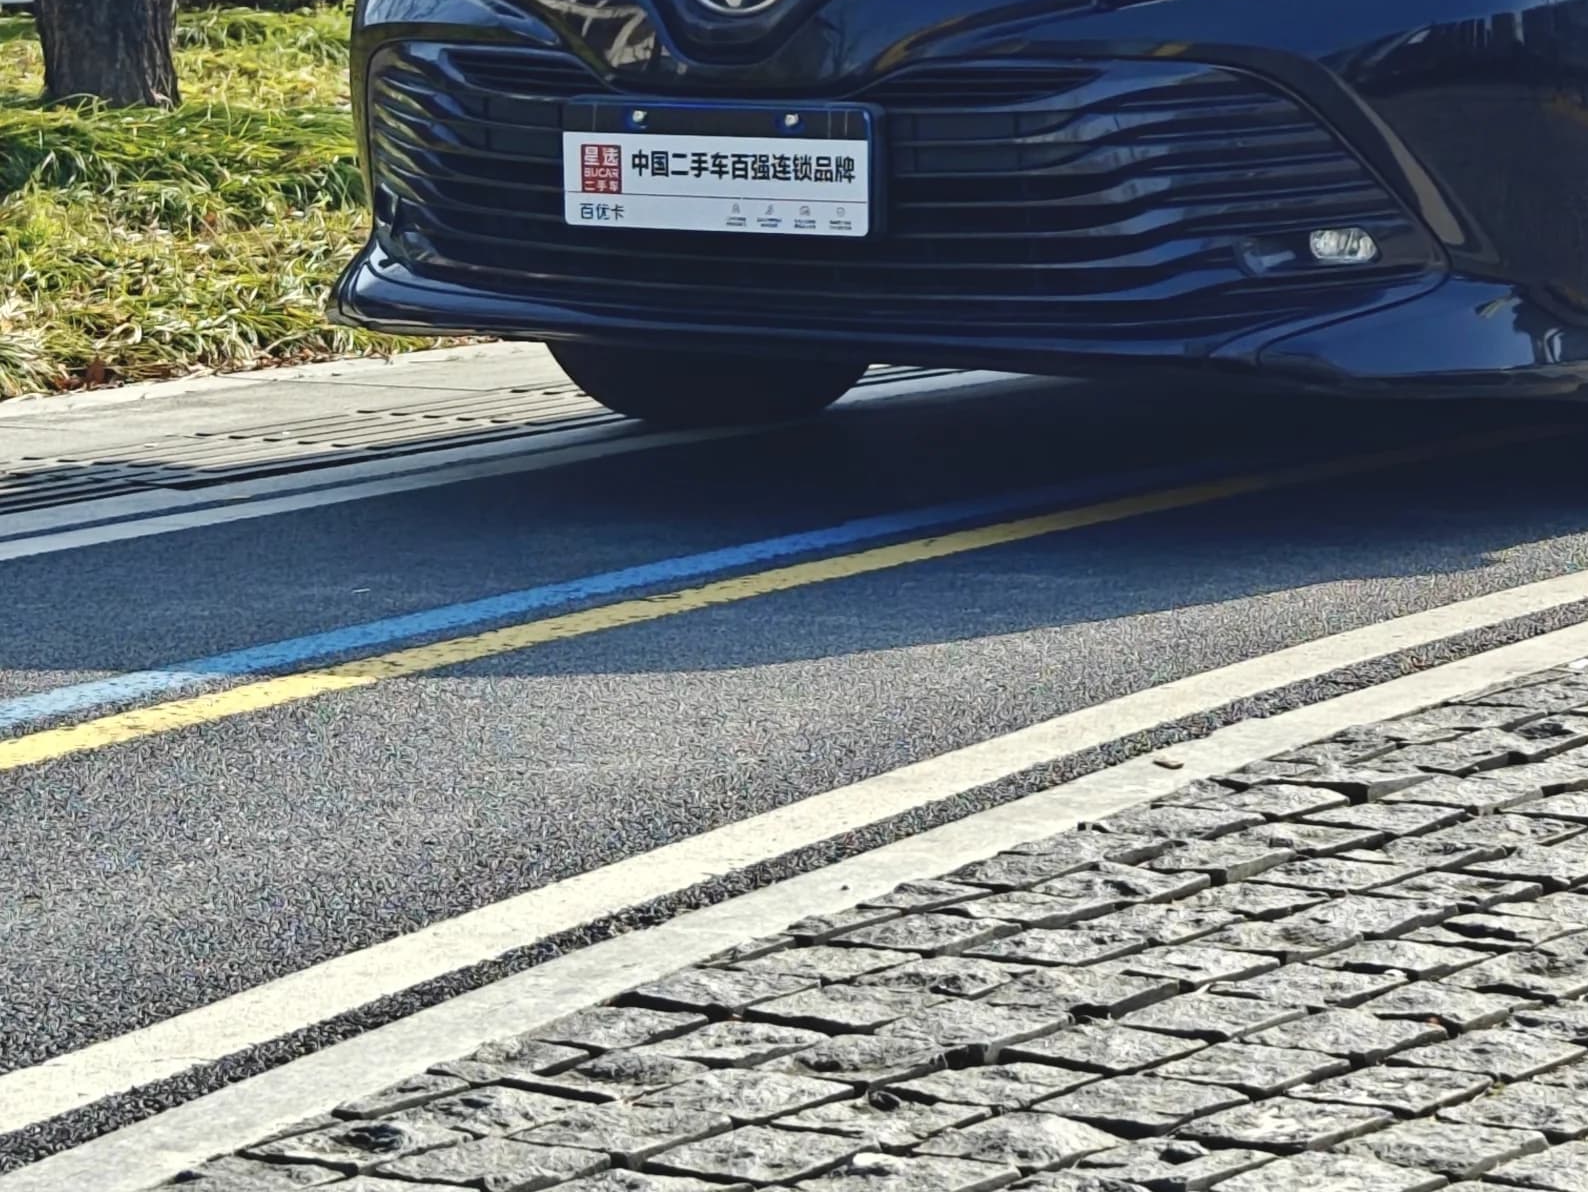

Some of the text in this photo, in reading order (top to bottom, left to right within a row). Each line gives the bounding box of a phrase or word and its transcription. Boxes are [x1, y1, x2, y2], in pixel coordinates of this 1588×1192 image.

[583, 167, 619, 179] BUCAR
[631, 149, 856, 184] 中国二手车百强连锁品牌
[584, 180, 619, 192] 二手车
[579, 202, 624, 221] 百优卡
